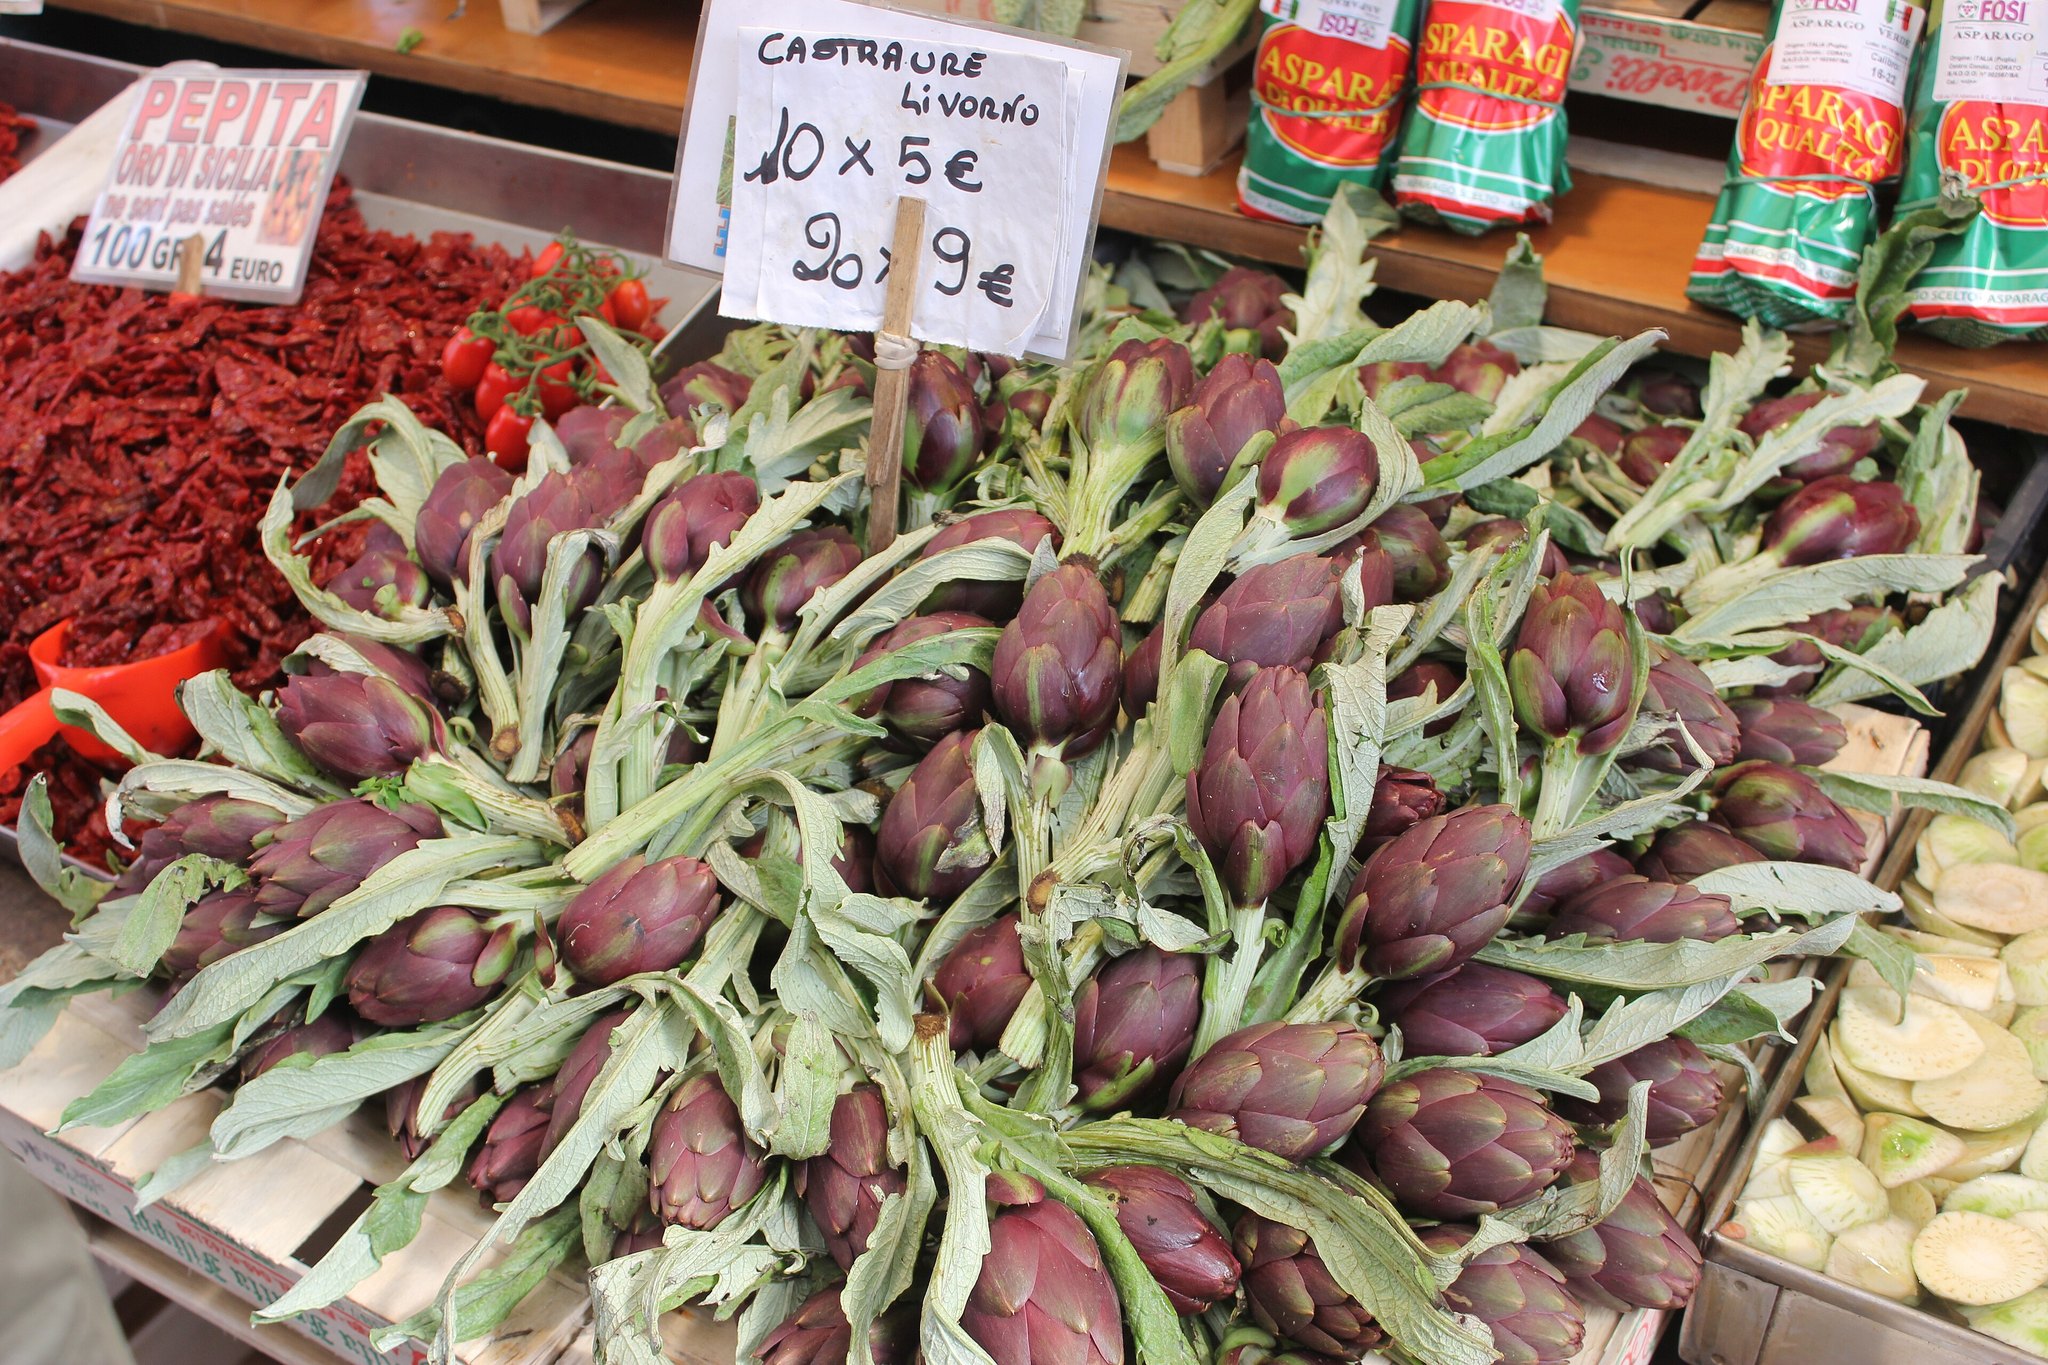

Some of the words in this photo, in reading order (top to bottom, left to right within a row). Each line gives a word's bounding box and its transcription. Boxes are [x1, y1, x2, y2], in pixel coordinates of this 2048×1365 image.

[1791, 19, 1865, 31] ASPARAGO
[1980, 0, 2027, 22] FOSI
[757, 31, 988, 78] CASTRAURE
[1419, 22, 1573, 82] SPARAGI
[1878, 27, 1912, 49] VERDE
[1954, 31, 2034, 42] ASPARAGO
[131, 79, 339, 148] PEPITA
[1948, 116, 2048, 153] ASPA
[743, 105, 825, 185] 10
[115, 143, 168, 187] ORO
[165, 145, 198, 188] DI
[193, 146, 278, 192] SICILIA
[101, 194, 128, 221] ne
[128, 191, 170, 222] sont
[164, 197, 202, 231] pas
[204, 191, 256, 228] salés
[91, 223, 153, 269] 100
[203, 229, 228, 277] 4
[230, 257, 283, 283] EURO
[792, 211, 863, 290] 20
[1987, 292, 2048, 304] ASPARAG
